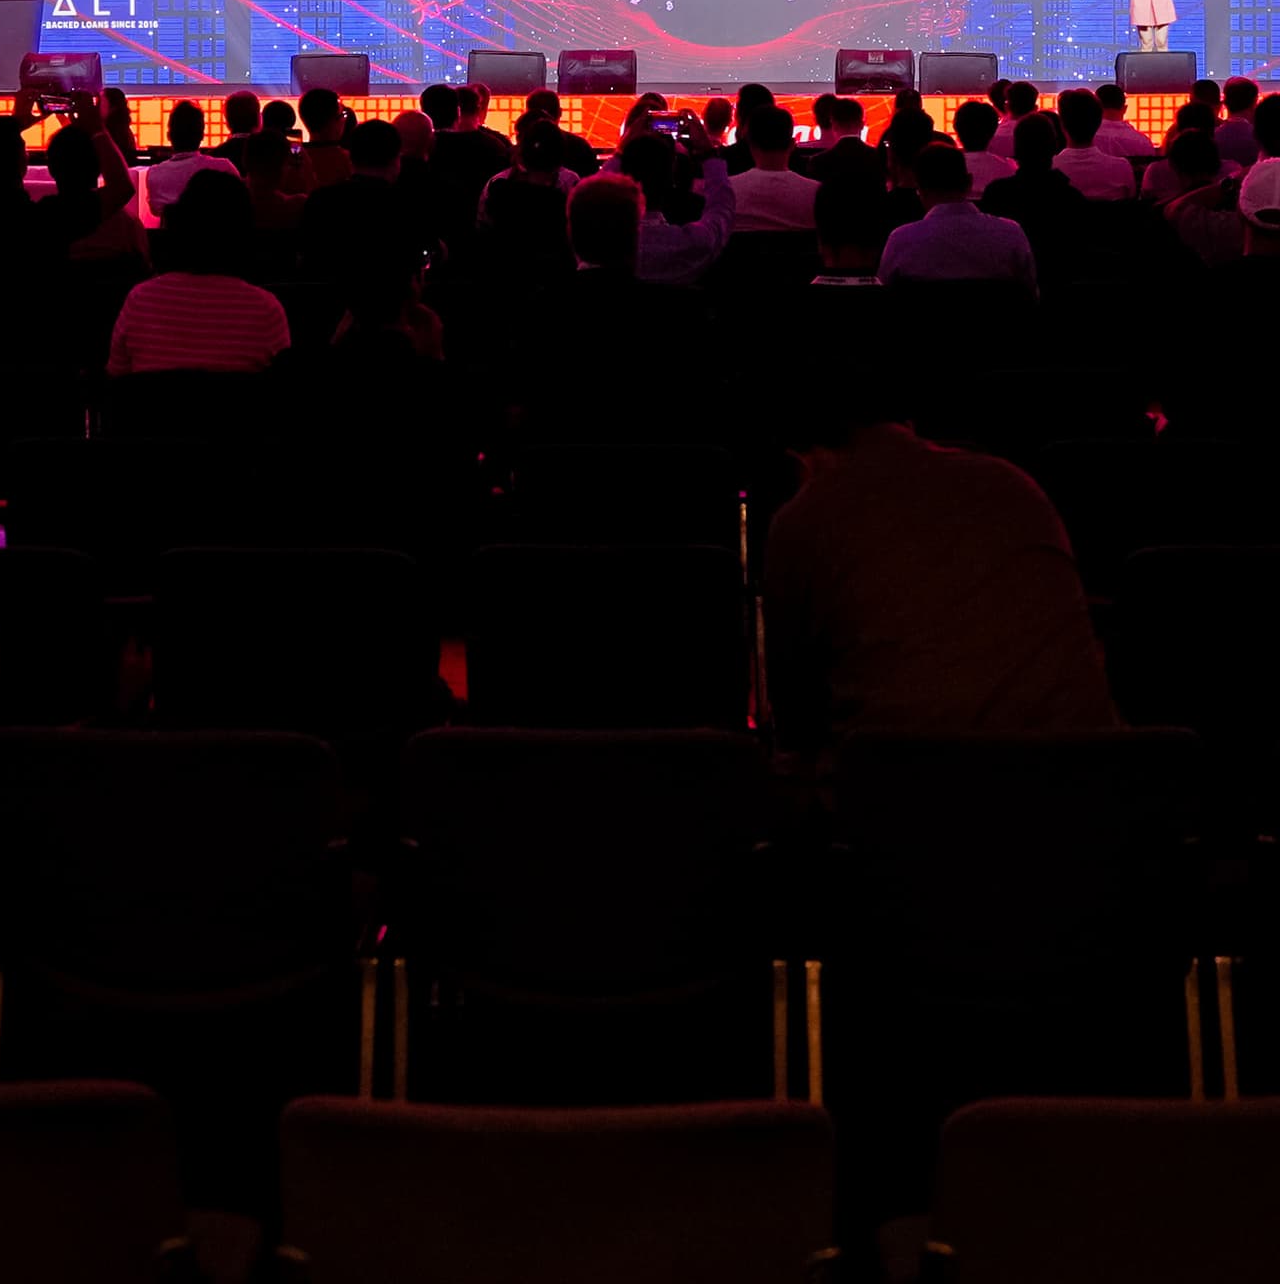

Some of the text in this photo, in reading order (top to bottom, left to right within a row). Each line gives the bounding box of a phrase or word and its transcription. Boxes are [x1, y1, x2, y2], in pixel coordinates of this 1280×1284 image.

[81, 20, 109, 29] LOANS
[111, 20, 136, 29] SINCE
[138, 20, 159, 29] 2016
